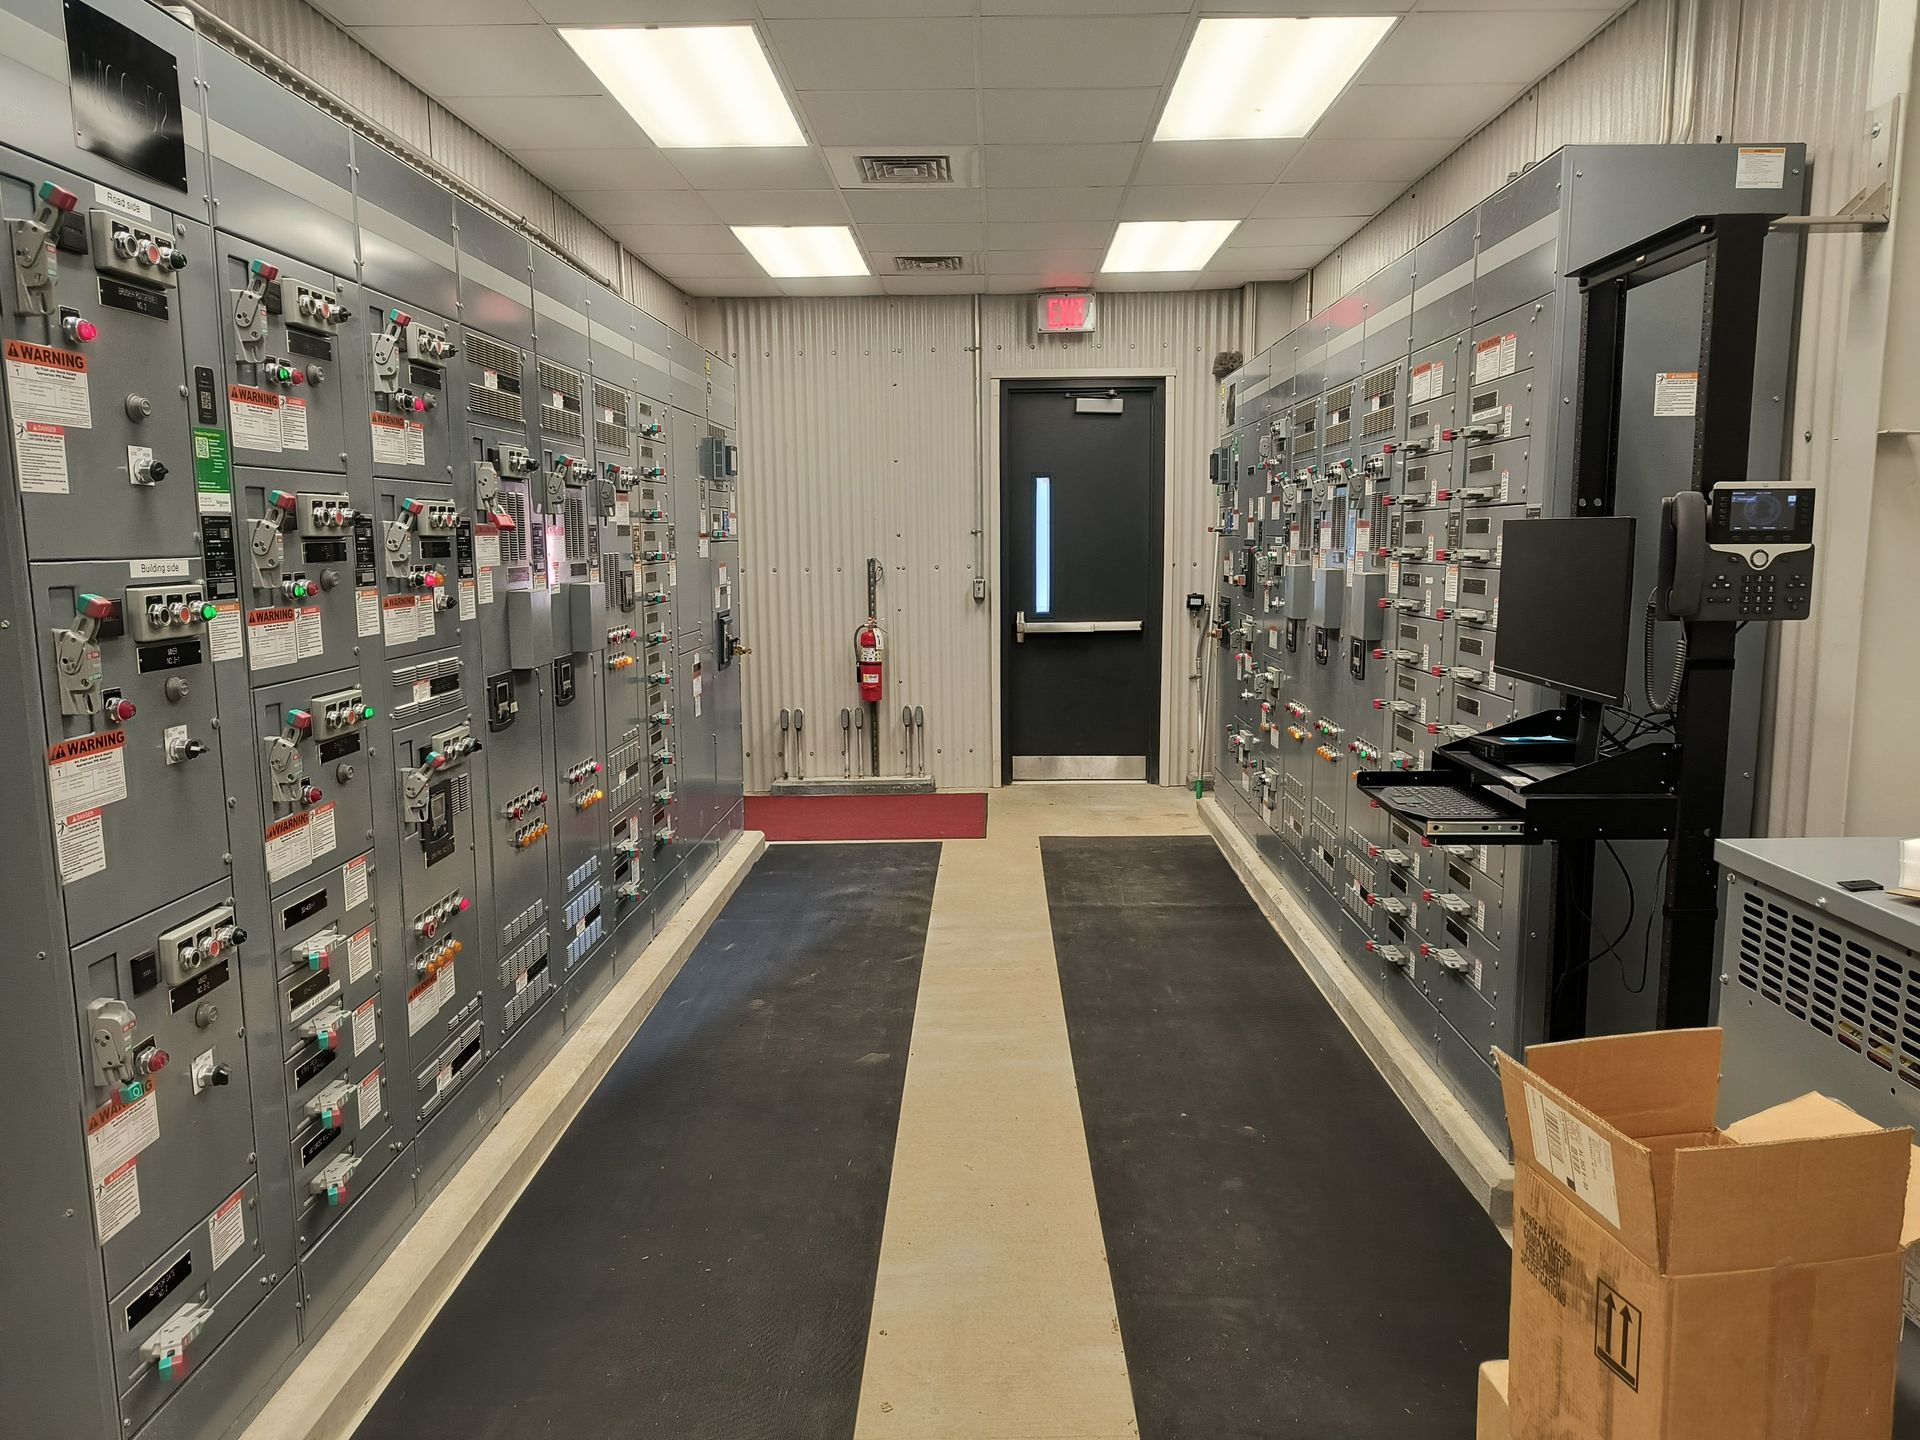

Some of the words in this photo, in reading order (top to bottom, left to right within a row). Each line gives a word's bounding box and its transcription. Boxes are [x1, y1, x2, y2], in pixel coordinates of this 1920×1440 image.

[106, 191, 125, 208] Road
[126, 201, 141, 213] side
[1048, 298, 1085, 328] EXIT
[20, 345, 84, 369] WARNING
[239, 389, 278, 406] WARNING
[141, 563, 165, 573] Building
[167, 563, 179, 572] side
[256, 609, 293, 623] WARNING
[67, 731, 125, 756] WARNING
[272, 813, 309, 836] WARNING
[1538, 1225, 1572, 1267] PACKAGES
